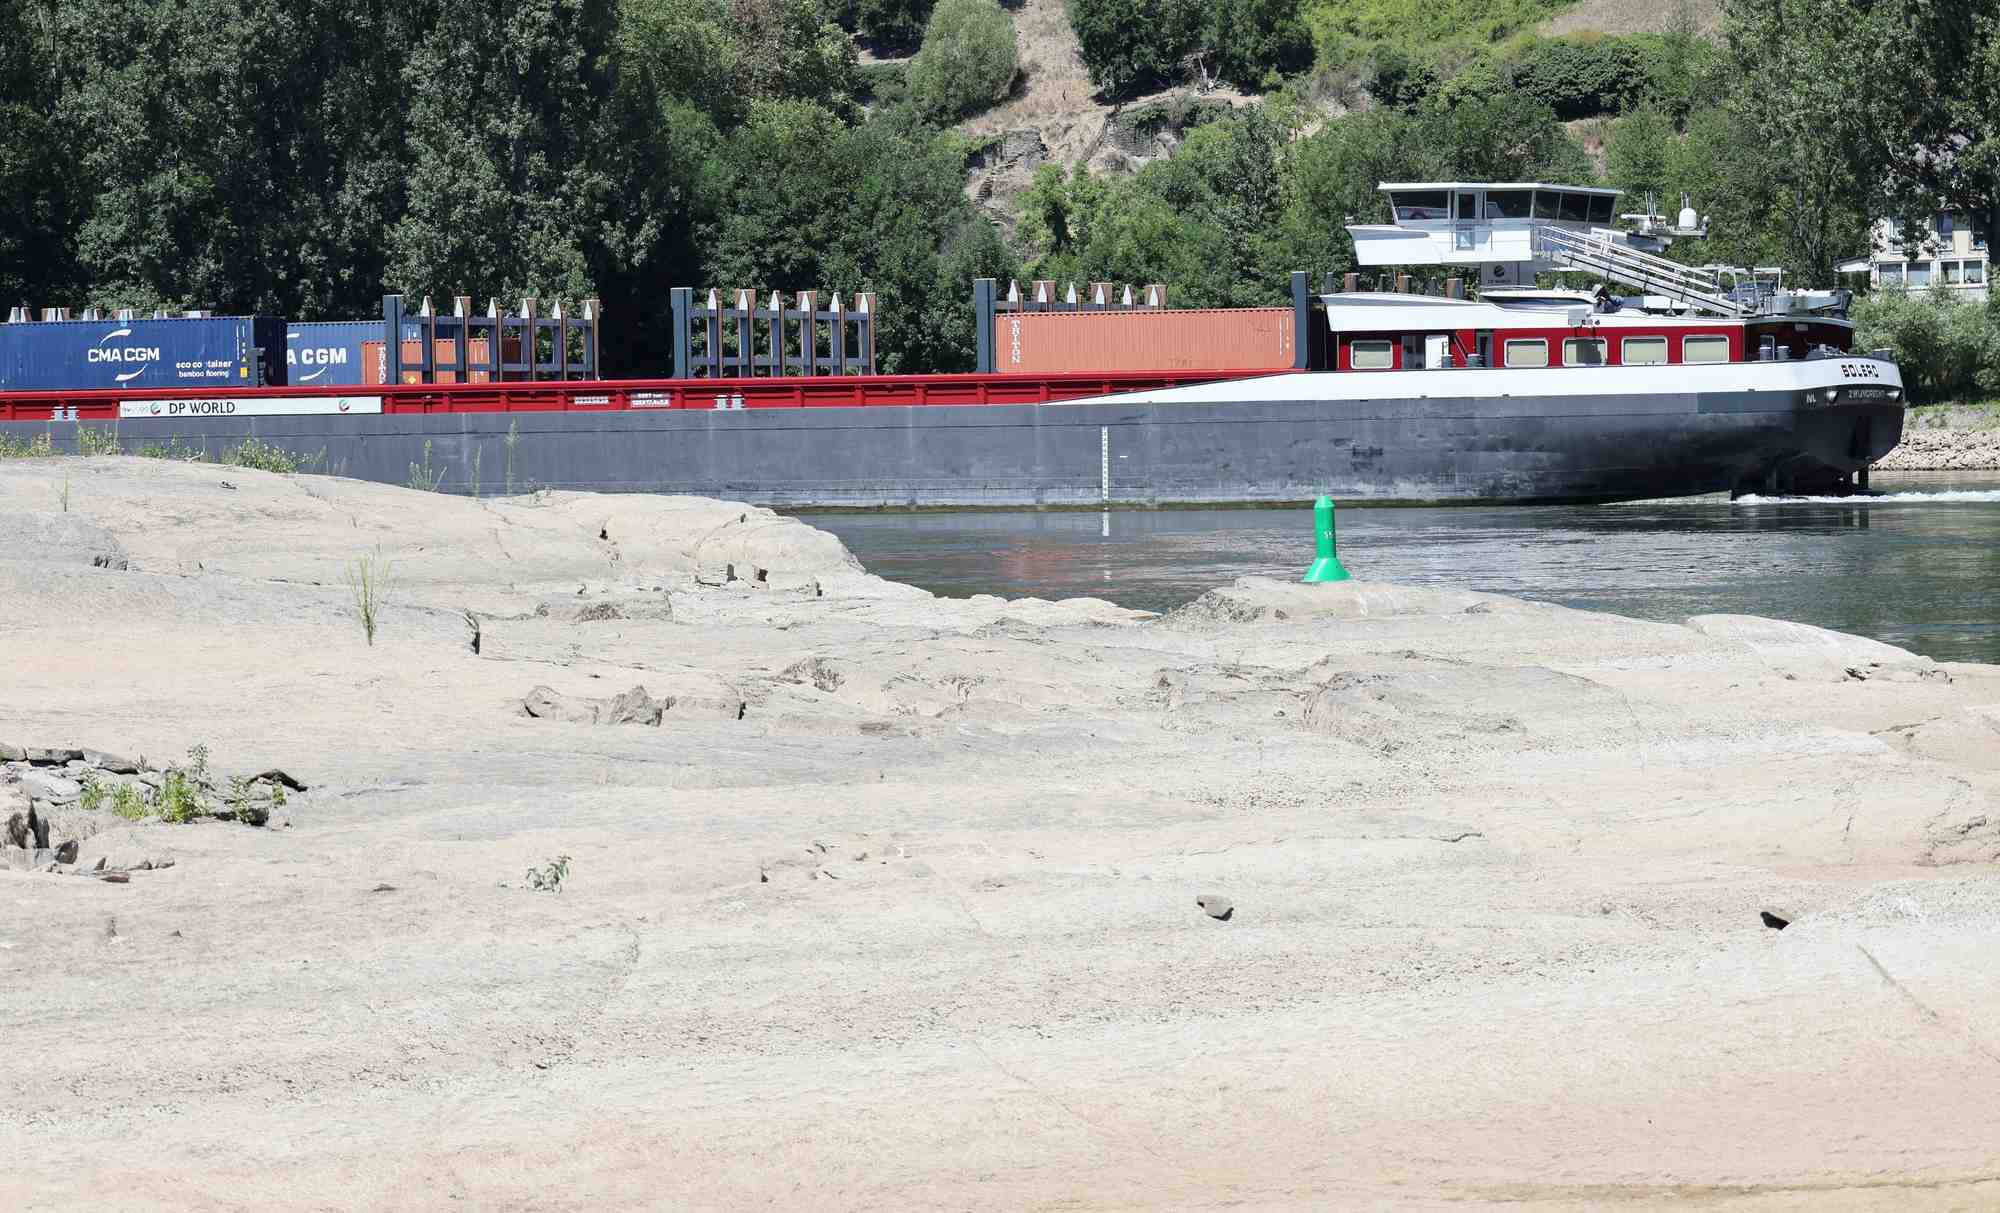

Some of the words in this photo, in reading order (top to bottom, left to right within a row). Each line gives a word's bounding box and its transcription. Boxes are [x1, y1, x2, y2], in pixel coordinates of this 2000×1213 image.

[1011, 320, 1020, 363] TRITON
[88, 348, 122, 363] CMA
[124, 347, 160, 361] CGM
[302, 348, 347, 364] CGM
[192, 360, 232, 368] cotainer
[1841, 364, 1879, 377] BOLERO
[206, 370, 230, 378] flooring
[169, 403, 186, 414] DP
[189, 401, 236, 414] WORLD
